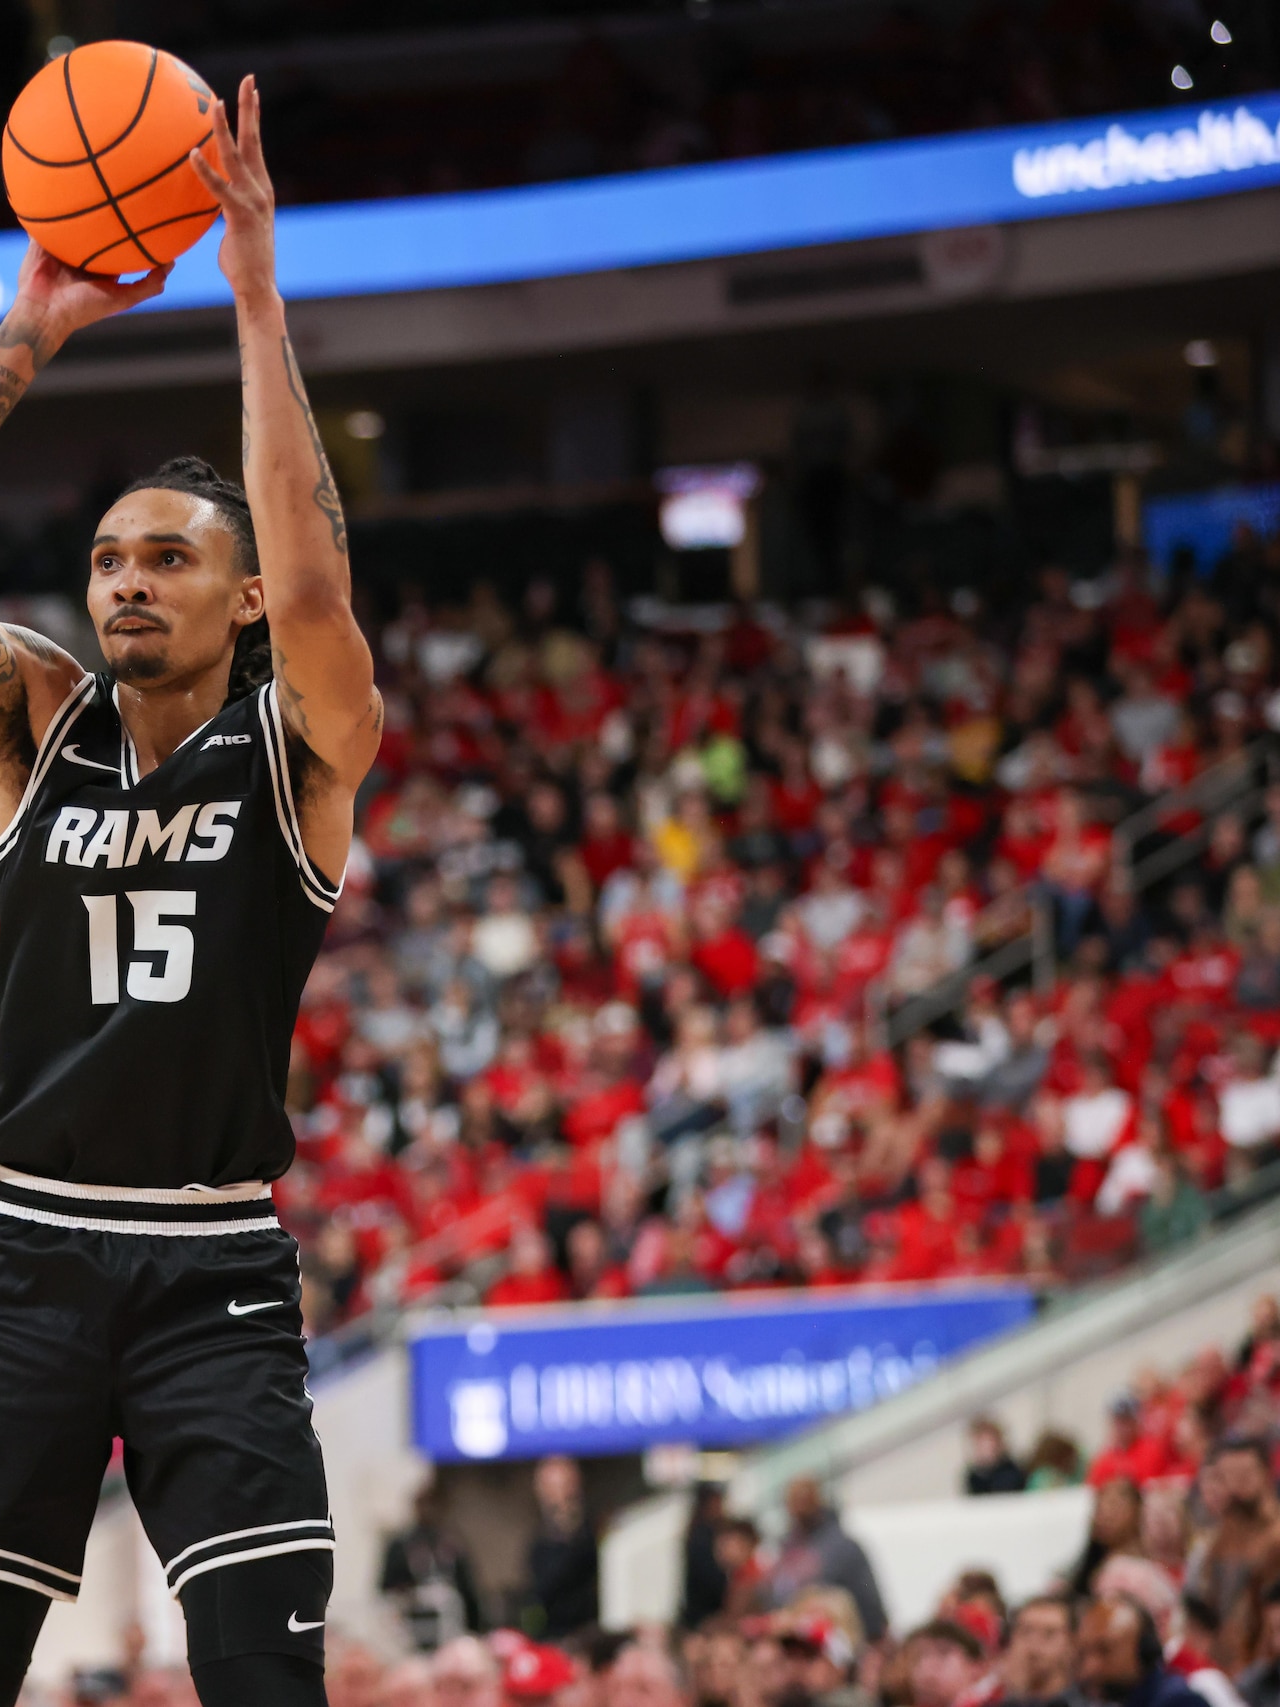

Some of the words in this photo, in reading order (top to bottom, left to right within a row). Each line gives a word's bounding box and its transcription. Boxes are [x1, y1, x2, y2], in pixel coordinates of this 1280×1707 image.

[200, 734, 252, 751] A10
[45, 801, 242, 869] RAMS
[81, 890, 197, 1005] 15
